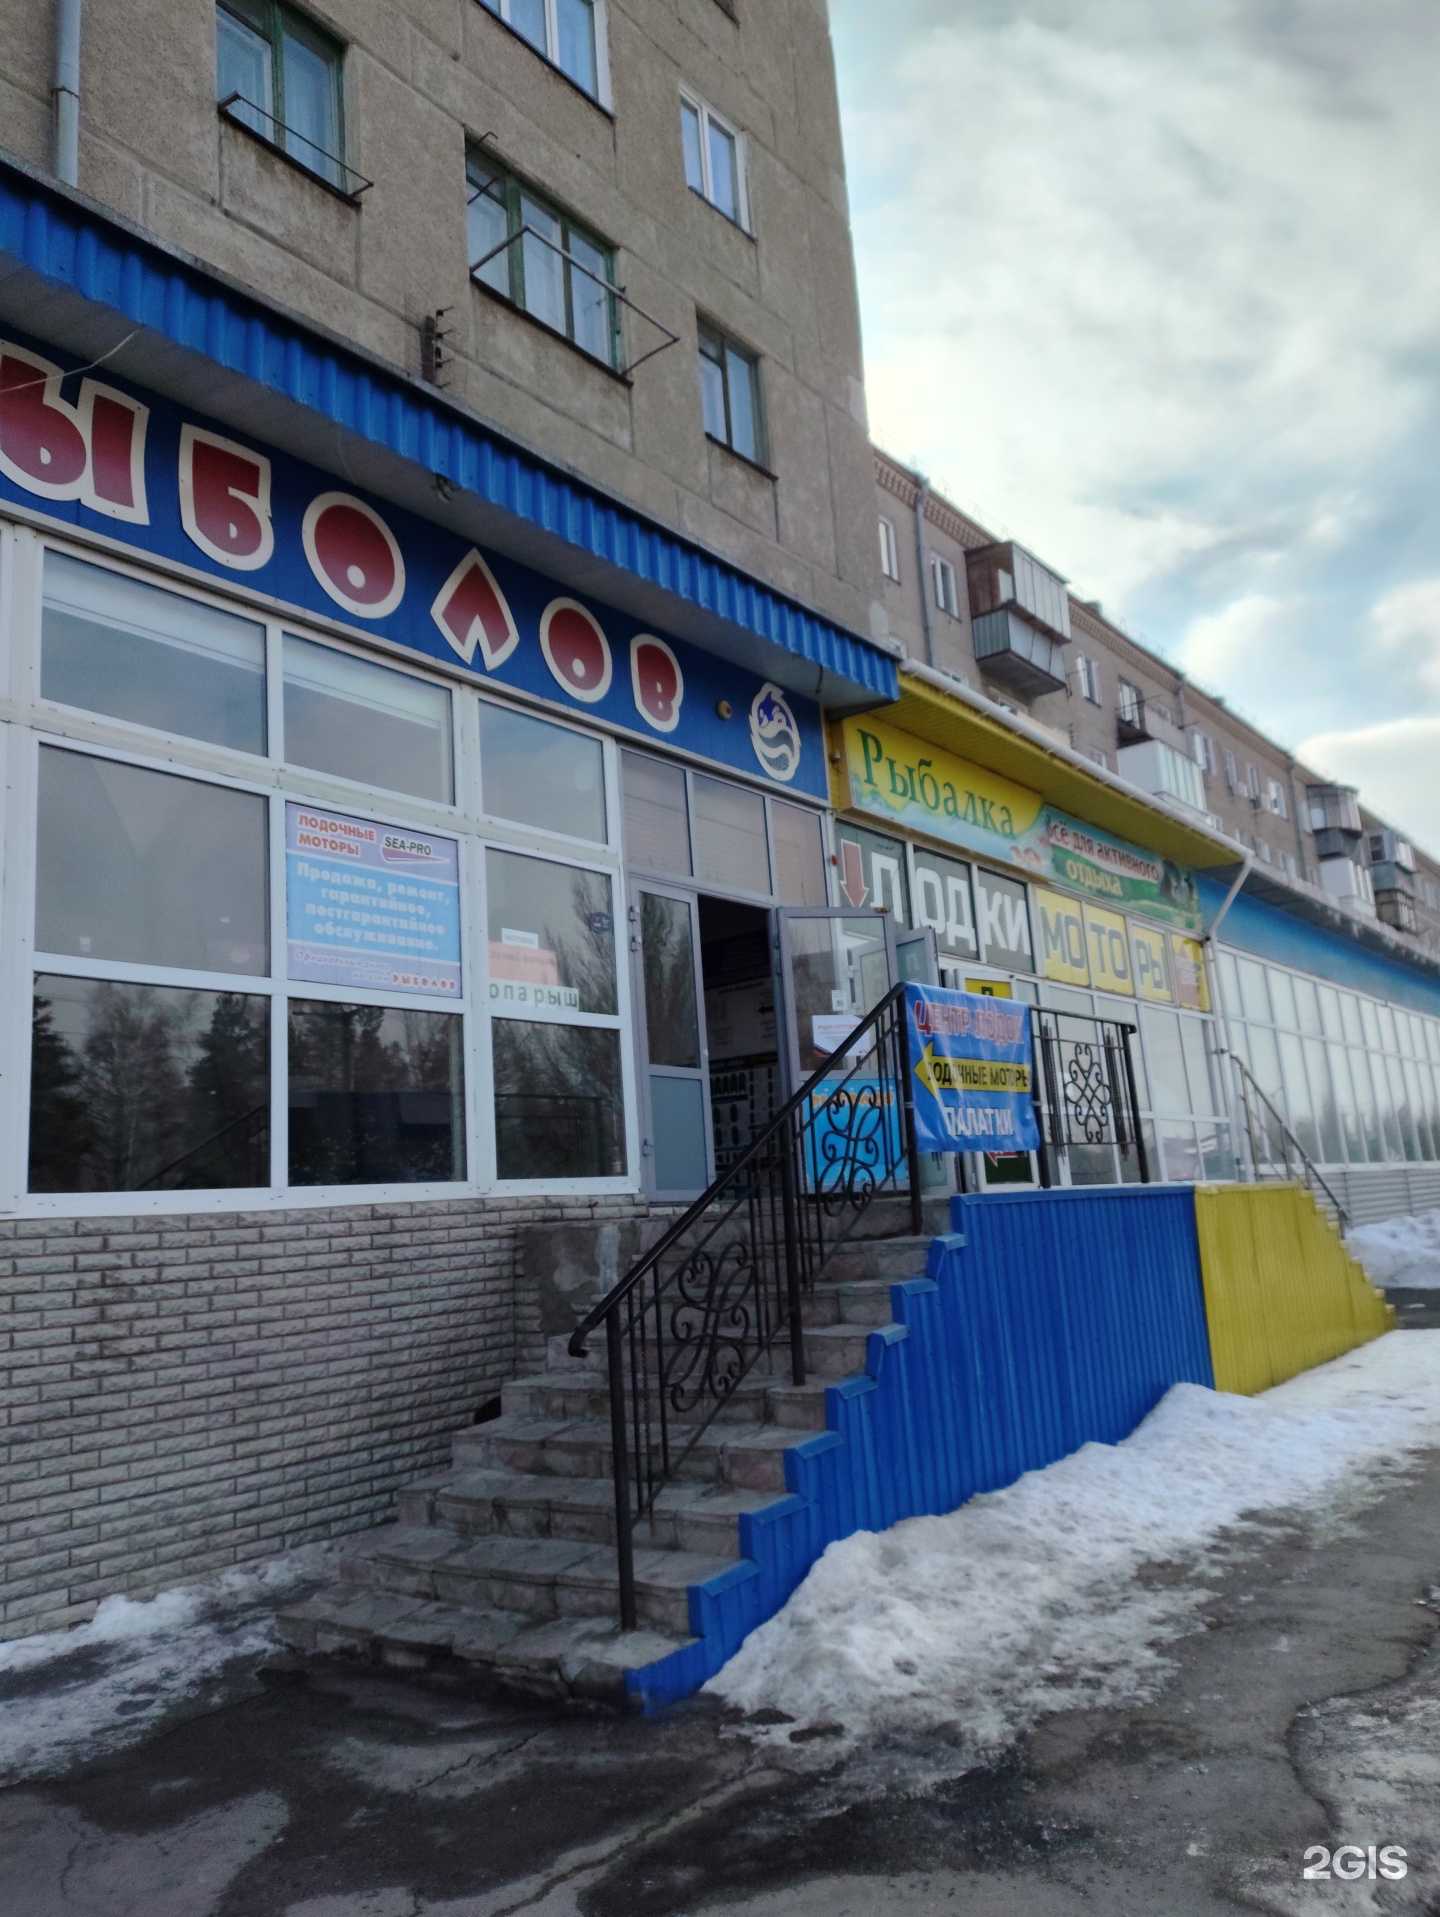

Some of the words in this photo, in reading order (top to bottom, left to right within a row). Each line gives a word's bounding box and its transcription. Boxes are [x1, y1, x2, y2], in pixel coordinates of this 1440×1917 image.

[857, 728, 1017, 840] Рыбалка
[298, 814, 376, 842] ЛОДОЧНЫЕ
[298, 834, 360, 856] МОТОРЫ
[384, 836, 432, 857] SEA-PRO
[870, 851, 1032, 956] ЛОДКИ
[1040, 906, 1168, 991] МОТОРЫ
[489, 983, 578, 1008] опарыш
[944, 1107, 1015, 1136] ПАЛАТКИ
